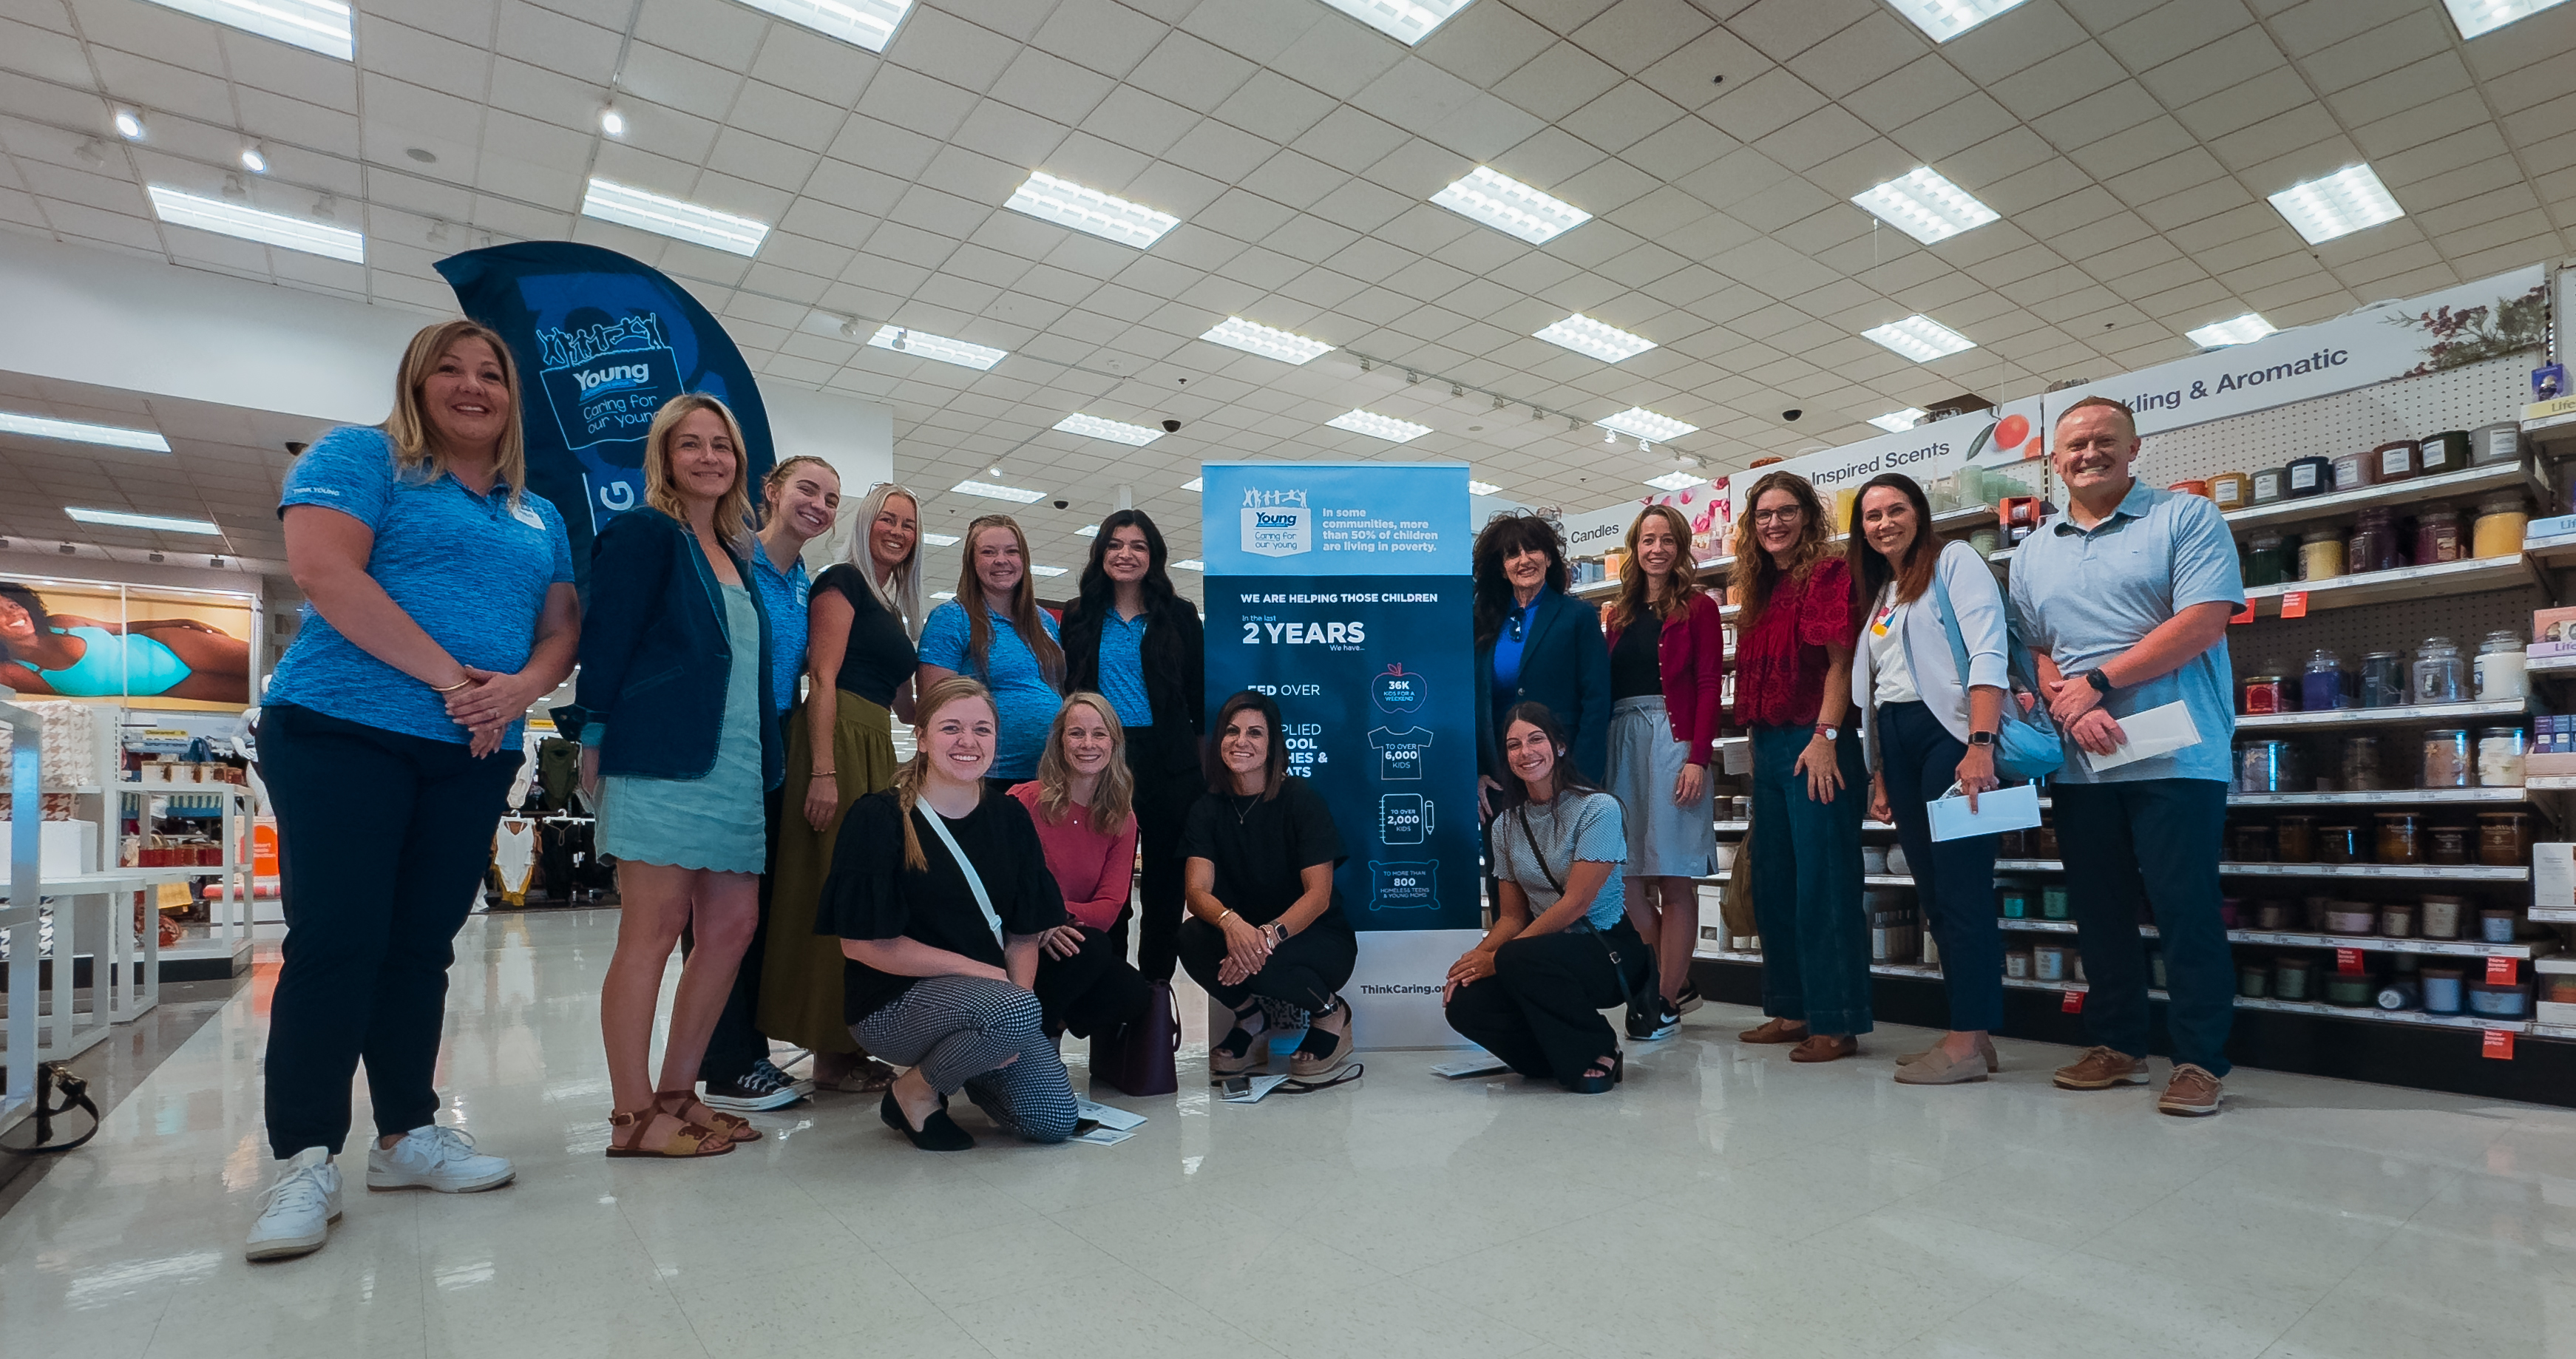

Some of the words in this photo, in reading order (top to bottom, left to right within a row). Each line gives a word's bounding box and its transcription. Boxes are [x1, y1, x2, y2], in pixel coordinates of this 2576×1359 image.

[572, 364, 649, 391] Young
[2121, 390, 2180, 414] kling
[2189, 381, 2209, 400] &
[2215, 348, 2348, 395] Aromatic
[583, 399, 627, 420] Caring
[630, 394, 657, 408] for
[588, 416, 610, 434] our
[1811, 456, 1880, 486] Inspired
[1885, 442, 1950, 468] Scents
[313, 487, 340, 496] YOUNG
[1322, 508, 1333, 517] In
[1255, 512, 1297, 526] Young
[1322, 519, 1397, 529] communities,
[1255, 532, 1280, 541] Caring
[1323, 530, 1348, 540] than
[1351, 530, 1376, 540] 50%
[1378, 530, 1391, 540] of
[1393, 530, 1438, 540] children
[1571, 524, 1619, 543] Candles
[1272, 541, 1297, 550] young
[1323, 543, 1341, 551] are
[1344, 541, 1375, 552] living
[1378, 541, 1389, 551] in
[1391, 542, 1437, 552] poverty.
[1241, 594, 1260, 603] WE
[1263, 594, 1287, 603] ARE
[1289, 594, 1338, 603] HELPING
[1340, 594, 1378, 603] THOSE
[1381, 594, 1438, 603] CHILDREN
[1243, 623, 1260, 644] 2
[1264, 622, 1366, 644] YEARS
[1281, 685, 1321, 696] OVER
[1389, 681, 1410, 690] 36K
[1281, 724, 1321, 736] PLIED
[1285, 738, 1318, 750] OOL
[1318, 751, 1328, 764] &
[1385, 750, 1417, 762] 6,000
[1286, 766, 1312, 778] ATS
[1387, 816, 1420, 826] 2,000
[1394, 878, 1416, 887] 800
[1360, 983, 1445, 995] ThinkCaring.or
